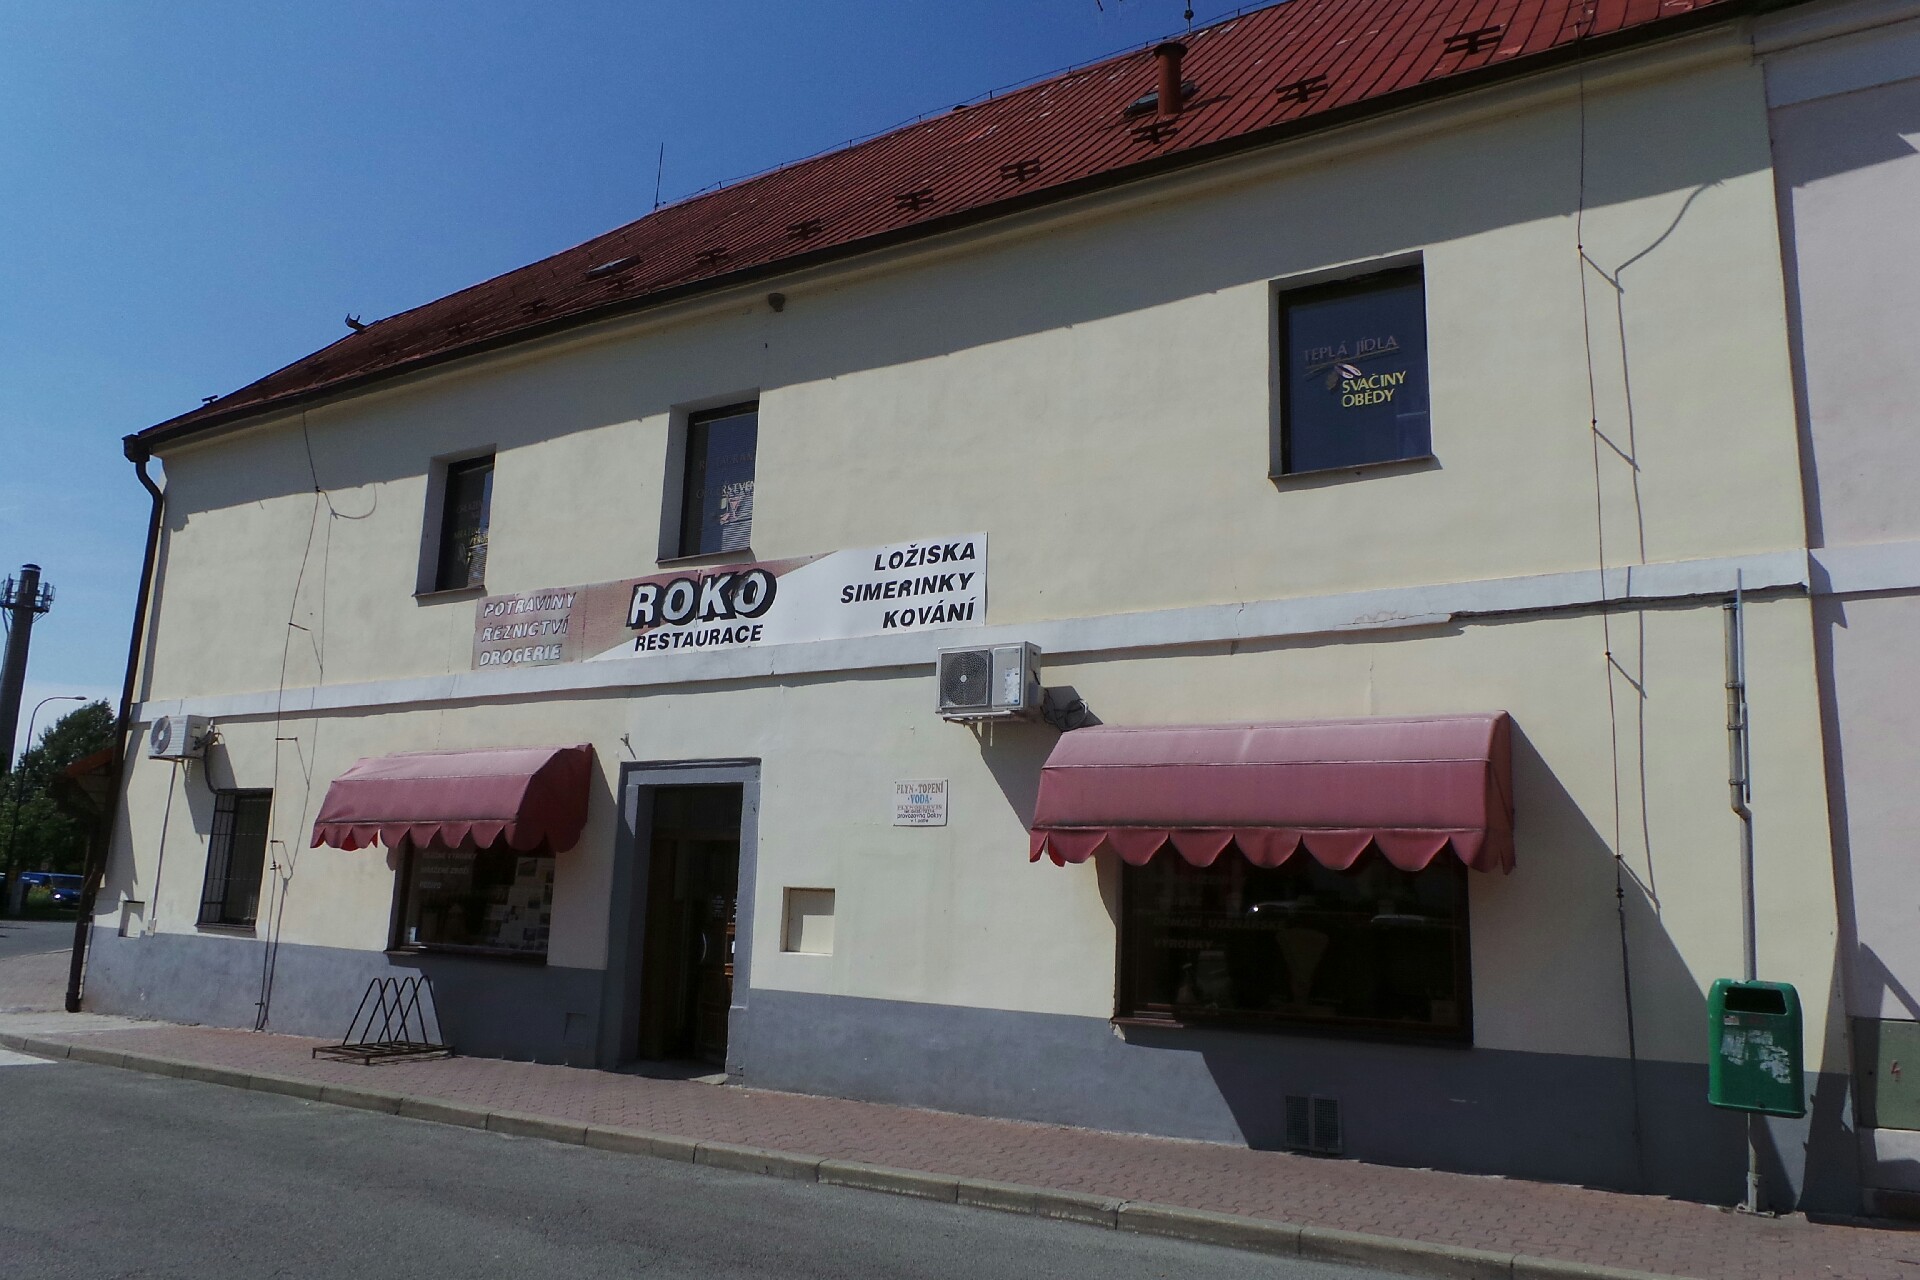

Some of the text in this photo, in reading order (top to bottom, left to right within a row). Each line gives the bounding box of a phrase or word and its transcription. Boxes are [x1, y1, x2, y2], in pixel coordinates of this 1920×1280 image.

[1303, 335, 1398, 361] TEPLÁ JÍDLA
[1342, 370, 1406, 394] SVAČINY
[1342, 388, 1395, 408] OBĚDY
[874, 543, 976, 571] LOŽISKA
[625, 568, 778, 630] ROKO
[840, 571, 976, 604] SIMERINKY
[483, 592, 576, 618] POTRAVINY
[882, 596, 977, 629] KOVÁNÍ
[634, 624, 764, 652] RESTAURACE
[479, 643, 563, 666] DROGERIE
